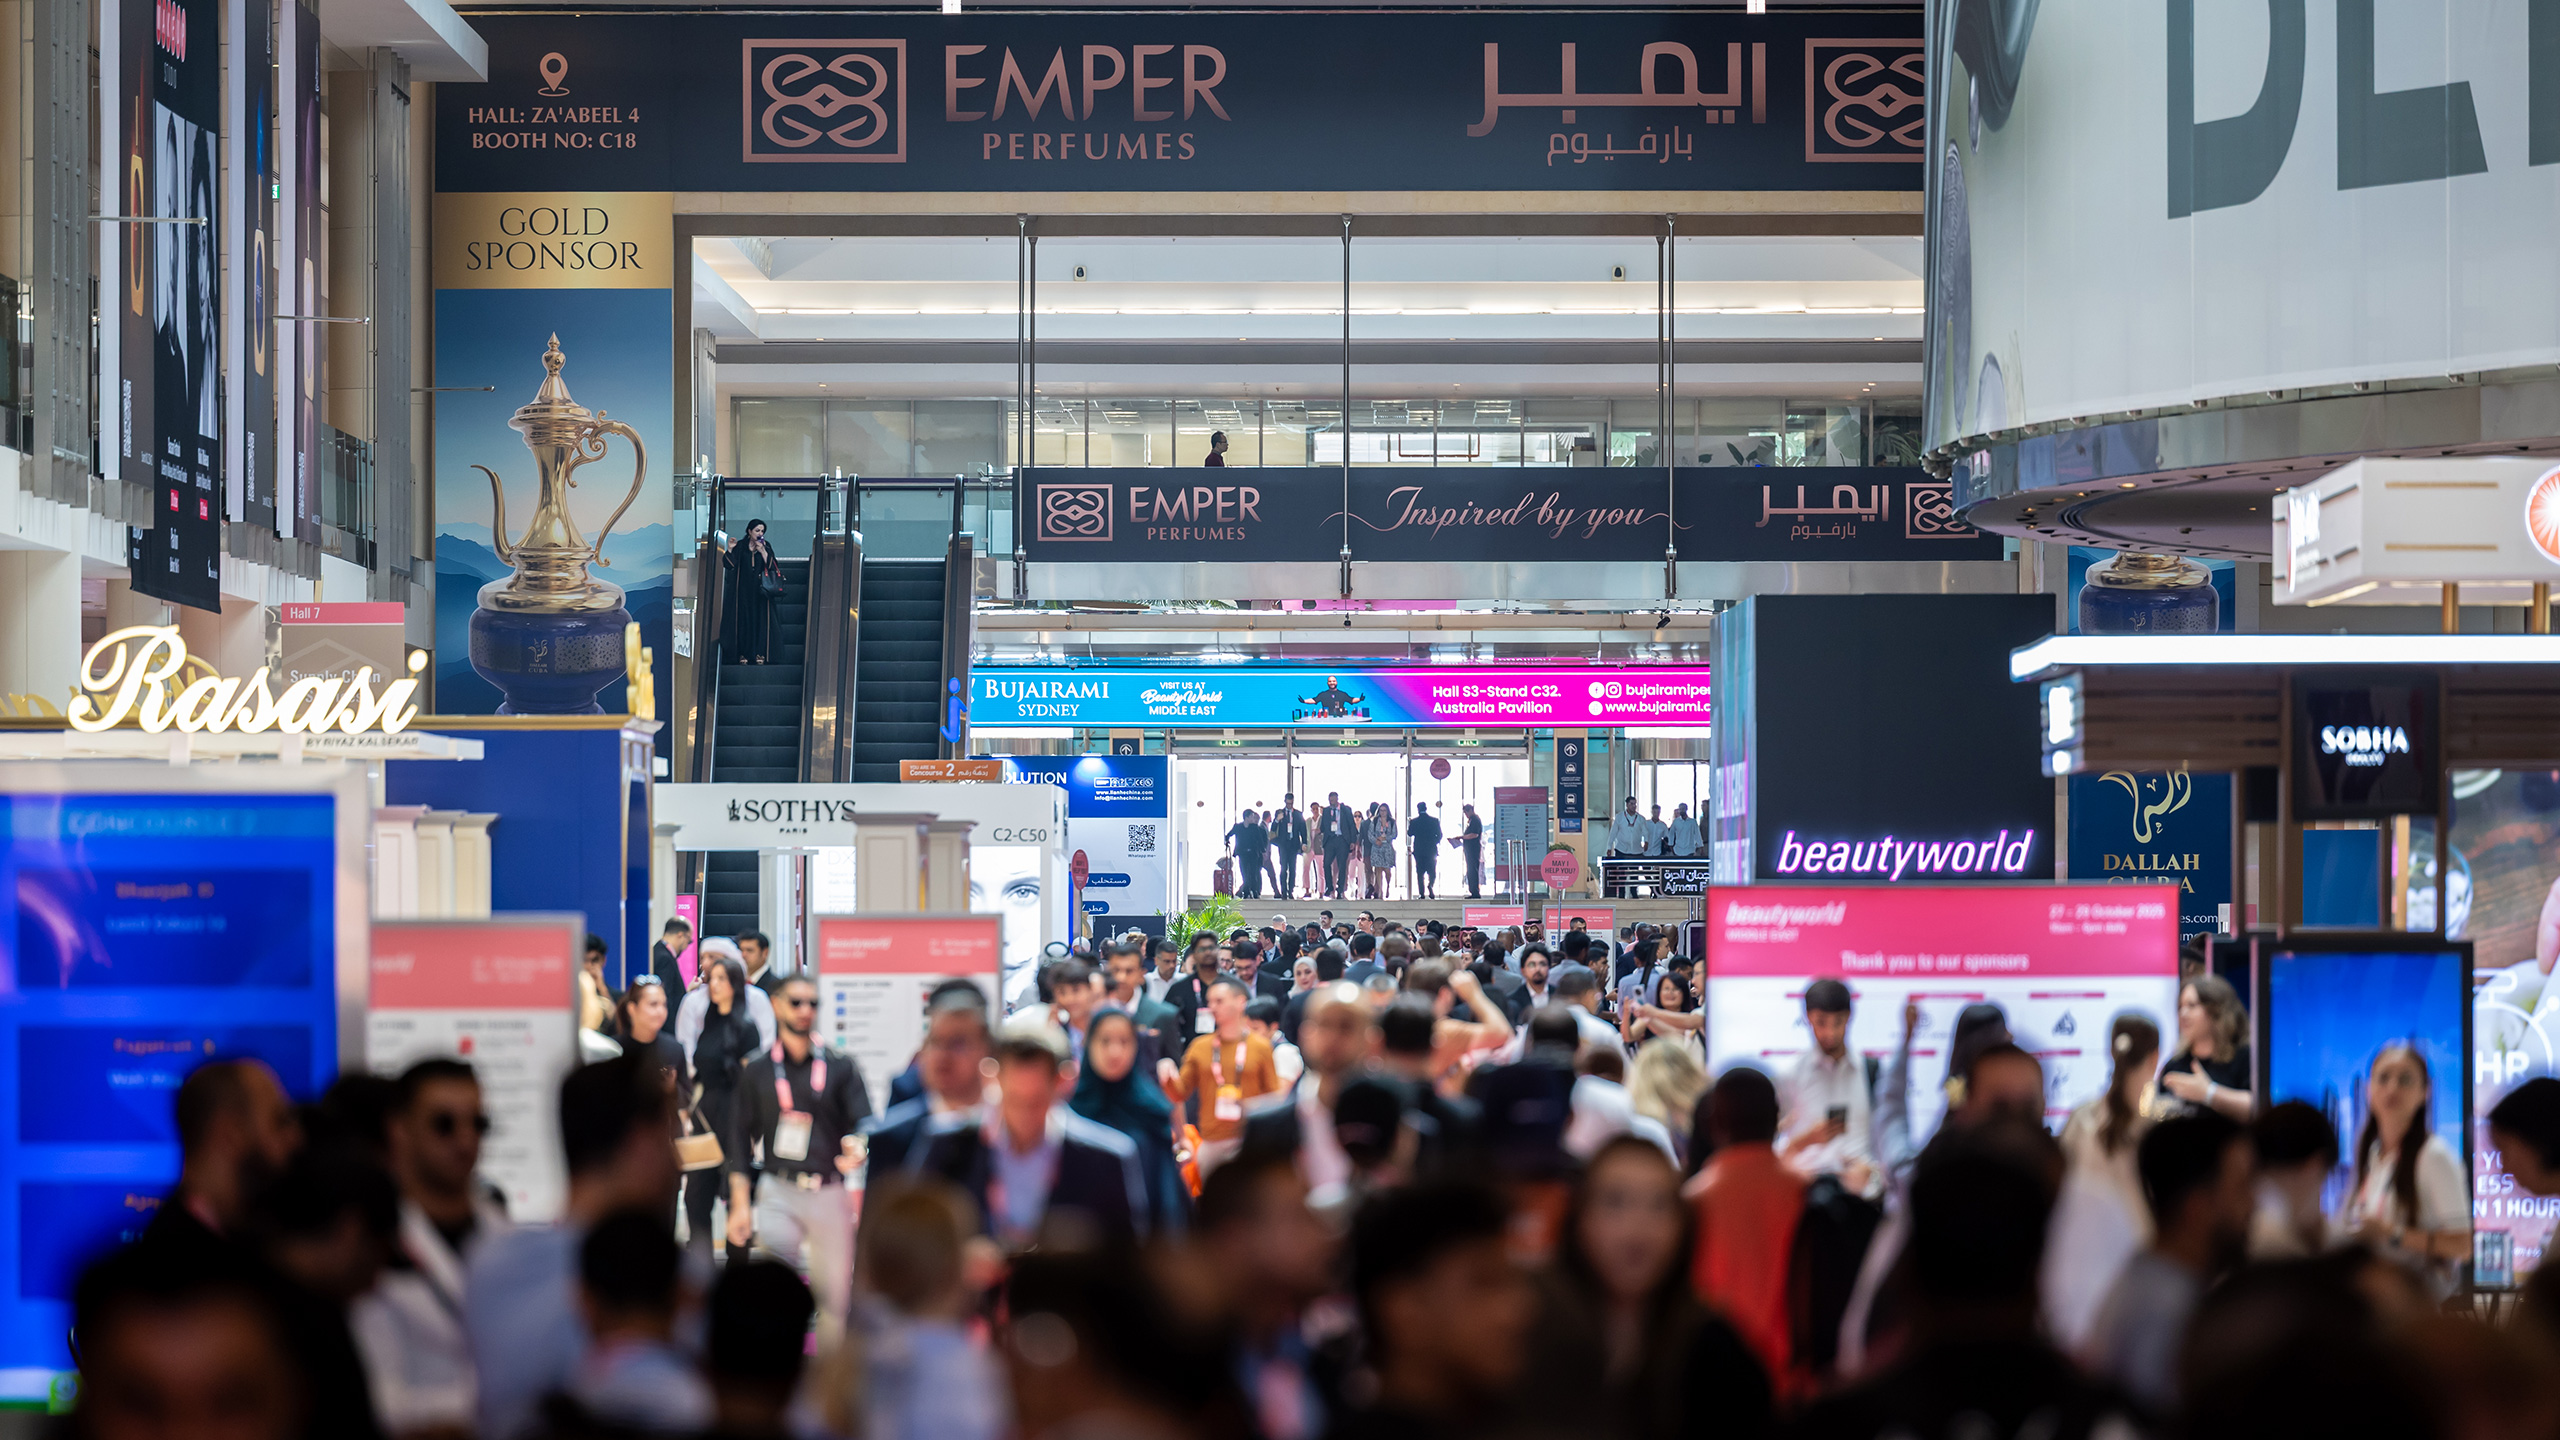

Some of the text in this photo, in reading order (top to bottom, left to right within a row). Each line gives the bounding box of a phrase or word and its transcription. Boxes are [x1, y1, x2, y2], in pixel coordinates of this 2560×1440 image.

[945, 45, 1232, 123] EMPER
[1467, 41, 1766, 137] ايمبر
[468, 107, 640, 124] HALL: ZA'ABEEL 4
[472, 132, 637, 149] BOOTH NO: C18
[983, 133, 1196, 161] PERFUMES
[1547, 125, 1693, 167] بارفيوم
[499, 207, 609, 236] GOLD
[466, 241, 644, 271] SPONSOR
[1130, 486, 1262, 523] EMPER
[1380, 486, 1648, 542] Inspired by you
[1755, 484, 1890, 528] ايمبر
[1147, 527, 1246, 542] PERFUMES
[1790, 522, 1857, 542] بارفيوم
[290, 607, 321, 619] Hall 7
[66, 623, 429, 736] Rasasi
[1159, 681, 1206, 690] VISIT US AT
[984, 679, 1110, 703] BUJAIRAMI
[1433, 685, 1562, 698] Hall S3-Stand C32.
[1018, 704, 1080, 718] SYDNEY
[1149, 705, 1217, 716] MIDDLE EAST
[1433, 702, 1552, 714] Australia Pavilion
[306, 736, 321, 748] BY
[323, 736, 356, 748] RIYAZ
[2321, 725, 2410, 755] SOBHA
[909, 763, 955, 777] Concourse 2
[1004, 772, 1067, 785] OLUTION
[744, 799, 856, 822] SOTHYS
[993, 828, 1047, 842] C2-C50
[1776, 829, 2035, 881] beautyworld
[2103, 853, 2200, 871] DALLAH
[1686, 869, 1710, 882] جمان
[1664, 881, 1698, 895] Ajman
[1726, 900, 1846, 929] beautyworld
[1840, 950, 2030, 974] Thank you to our sponsors
[2492, 1198, 2502, 1218] 1
